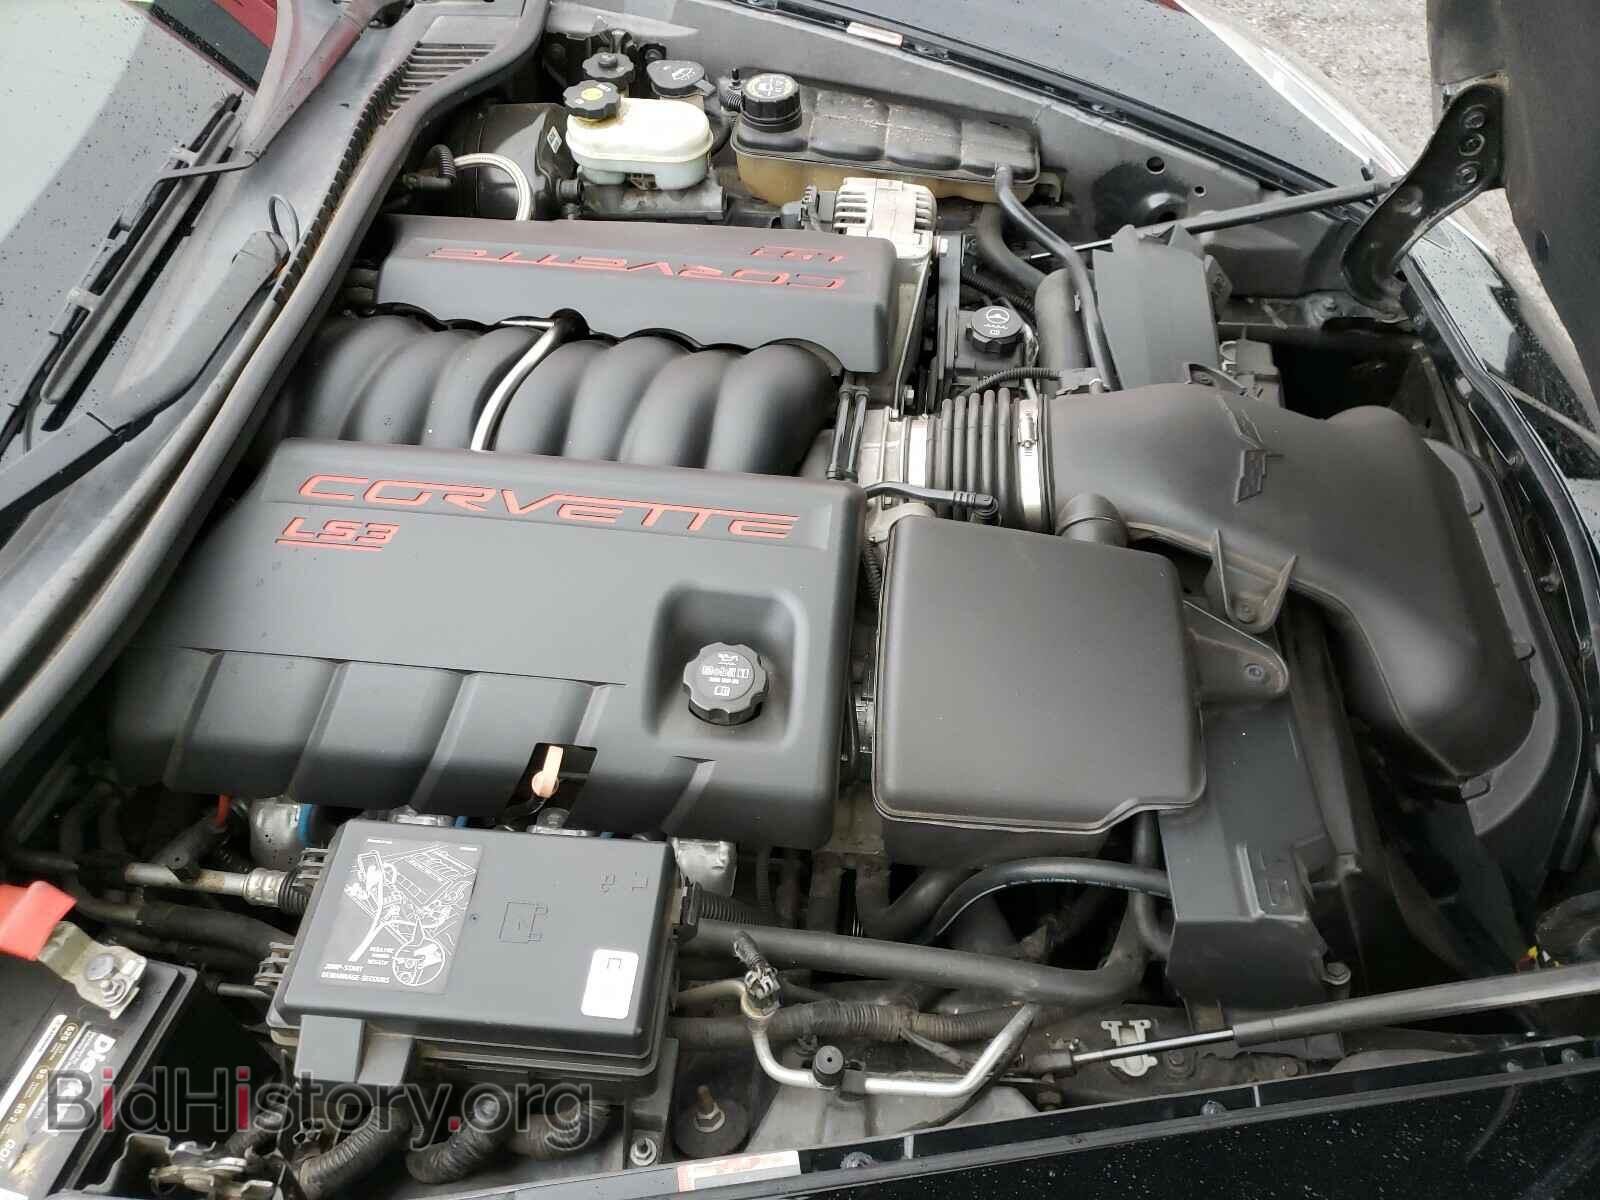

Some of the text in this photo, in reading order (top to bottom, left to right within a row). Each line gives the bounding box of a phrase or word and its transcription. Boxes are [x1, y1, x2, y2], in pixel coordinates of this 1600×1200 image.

[424, 247, 845, 290] CORVETTE
[298, 474, 800, 539] CORVETTE
[280, 516, 400, 546] LS3
